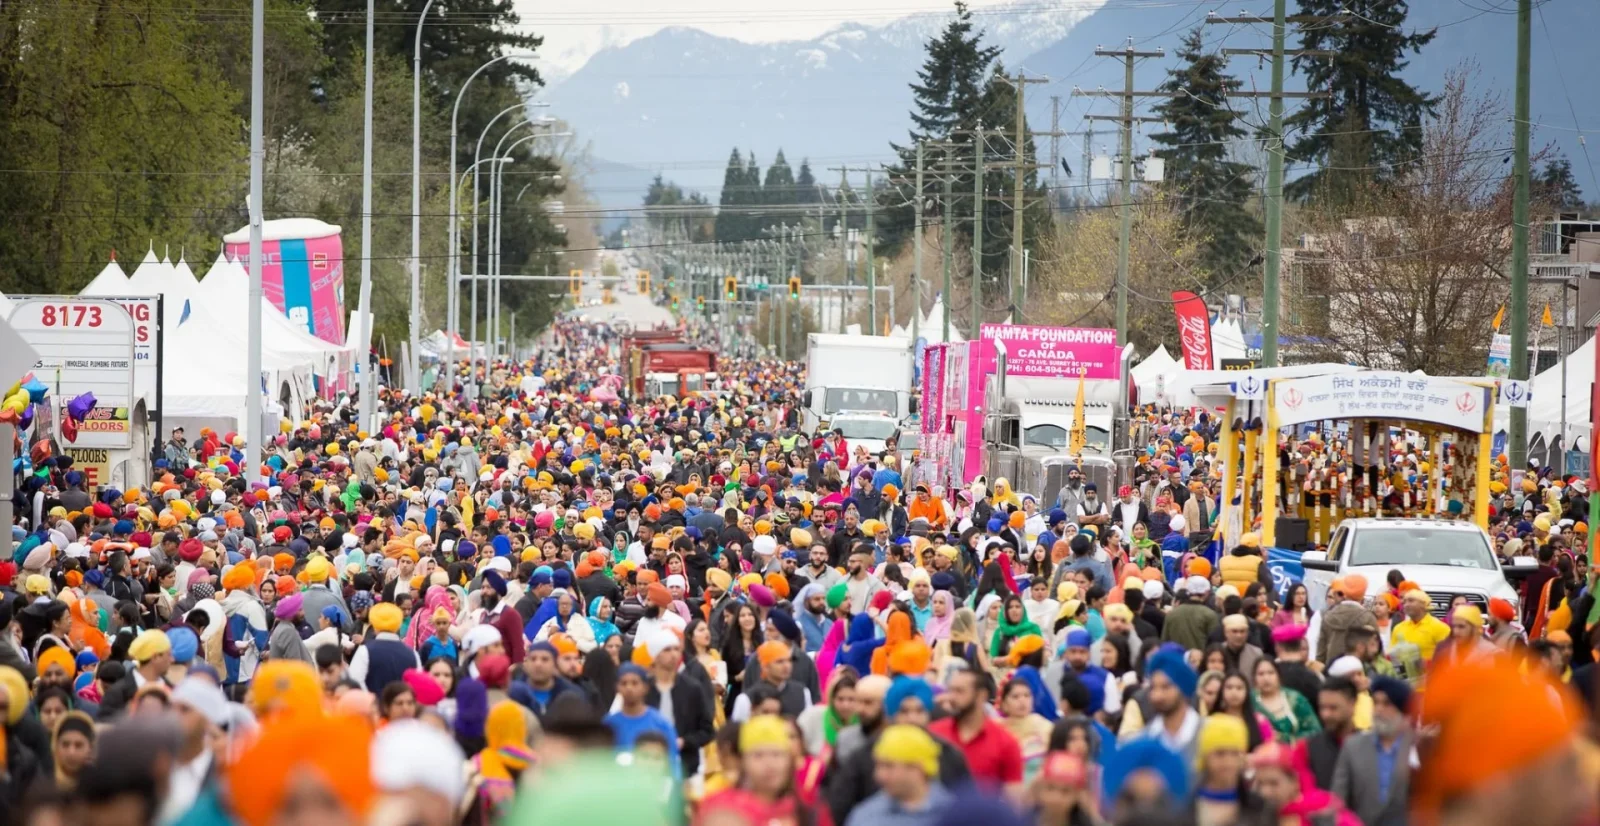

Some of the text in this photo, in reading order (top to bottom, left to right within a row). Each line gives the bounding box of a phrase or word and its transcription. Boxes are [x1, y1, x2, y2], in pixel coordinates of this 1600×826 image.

[42, 305, 102, 327] 8173
[984, 326, 1113, 343] MAMTA FOUNDATION
[1018, 349, 1075, 360] CANADA
[67, 360, 89, 368] WHOLESALE
[90, 360, 110, 368] PLUMBING
[111, 360, 129, 368] FIXTURES
[78, 421, 124, 431] FLOORS
[71, 449, 107, 463] FLOORS
